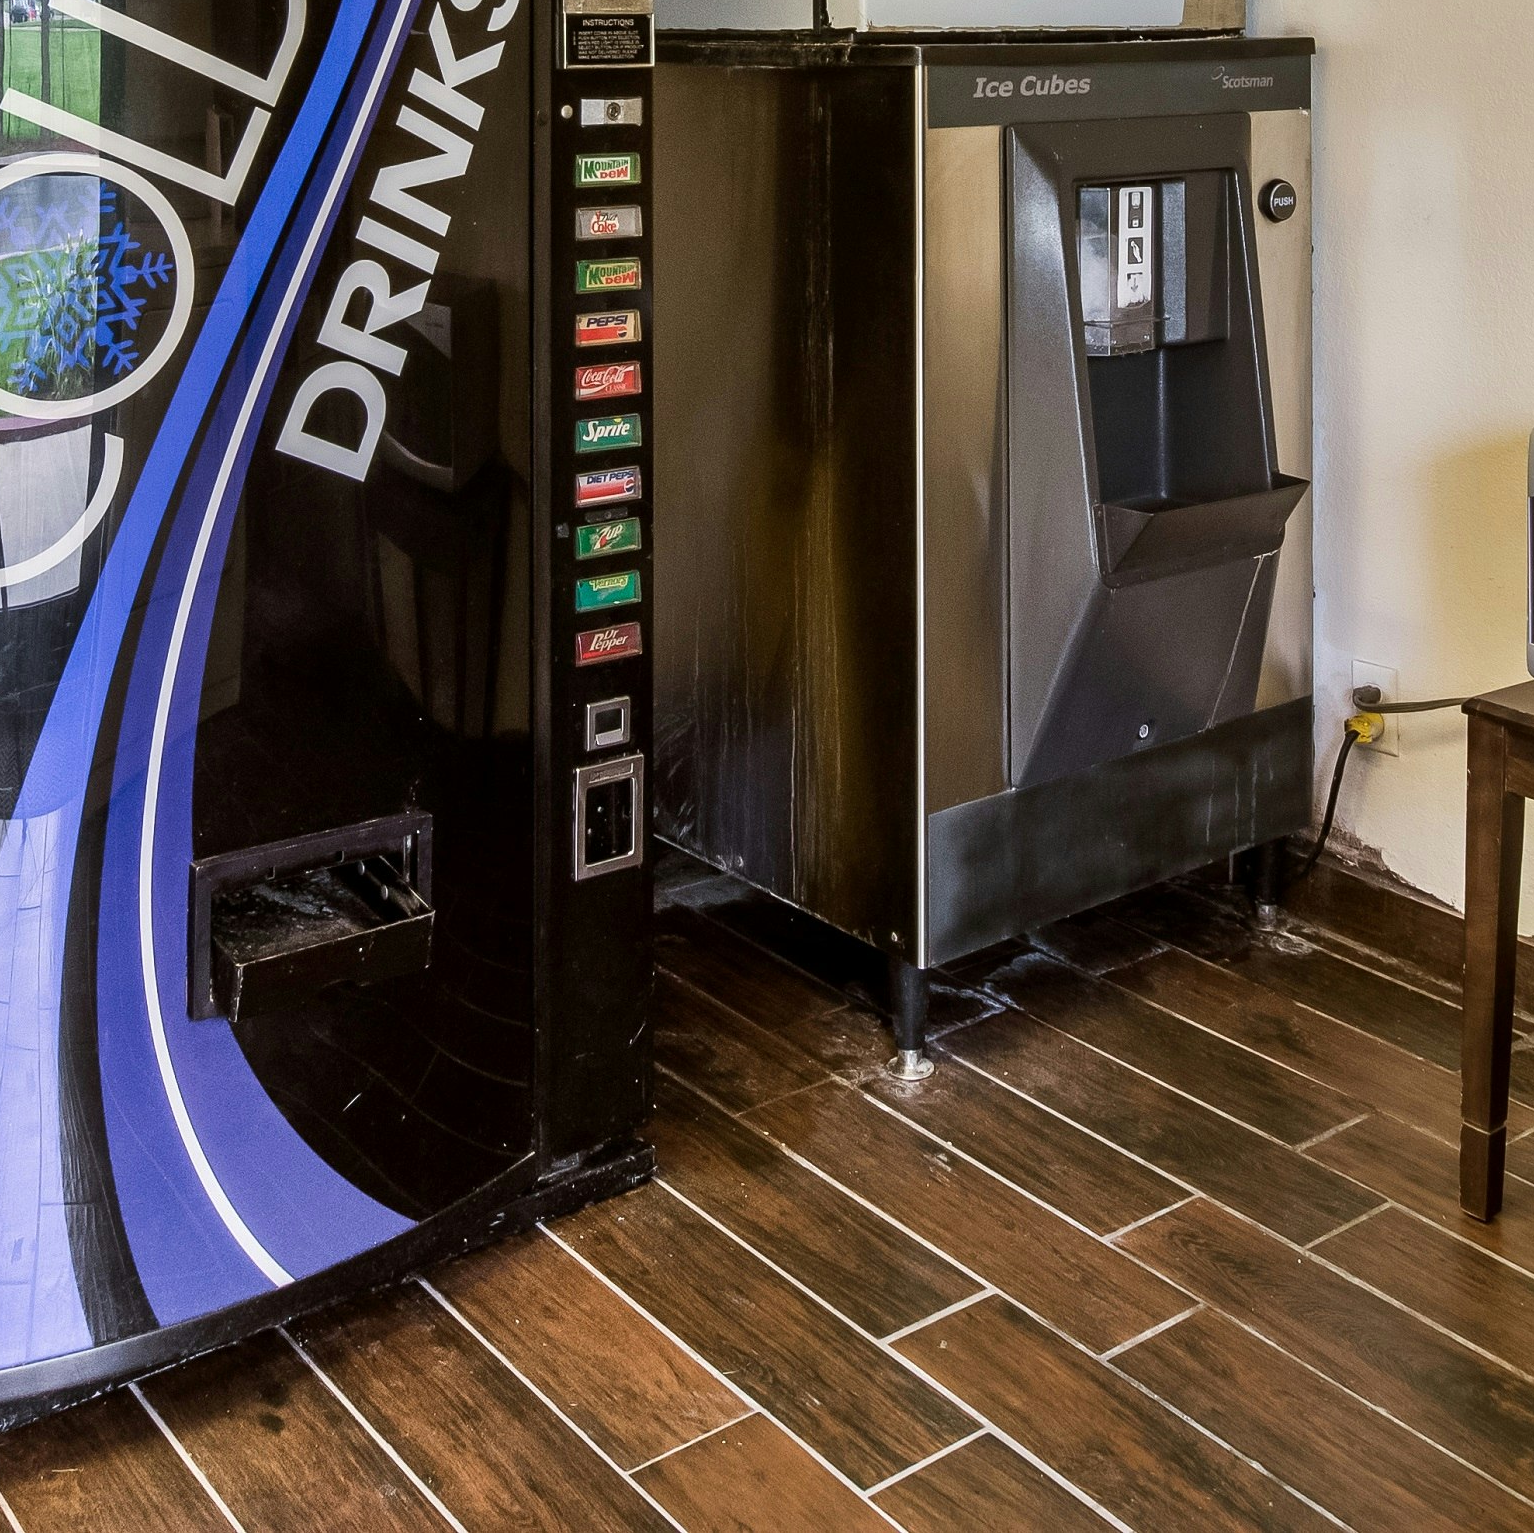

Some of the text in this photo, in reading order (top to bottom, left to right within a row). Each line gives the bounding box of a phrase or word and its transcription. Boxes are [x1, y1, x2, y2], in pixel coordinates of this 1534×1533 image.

[973, 74, 1091, 98] Ice Cubes
[1222, 75, 1274, 89] Scotsman
[1273, 196, 1294, 207] PUSH
[592, 221, 617, 233] Coke
[587, 315, 628, 327] PEPSI
[582, 420, 630, 442] Sprite
[587, 474, 608, 485] DIET
[604, 629, 620, 640] Dr
[589, 633, 629, 652] Pepper
